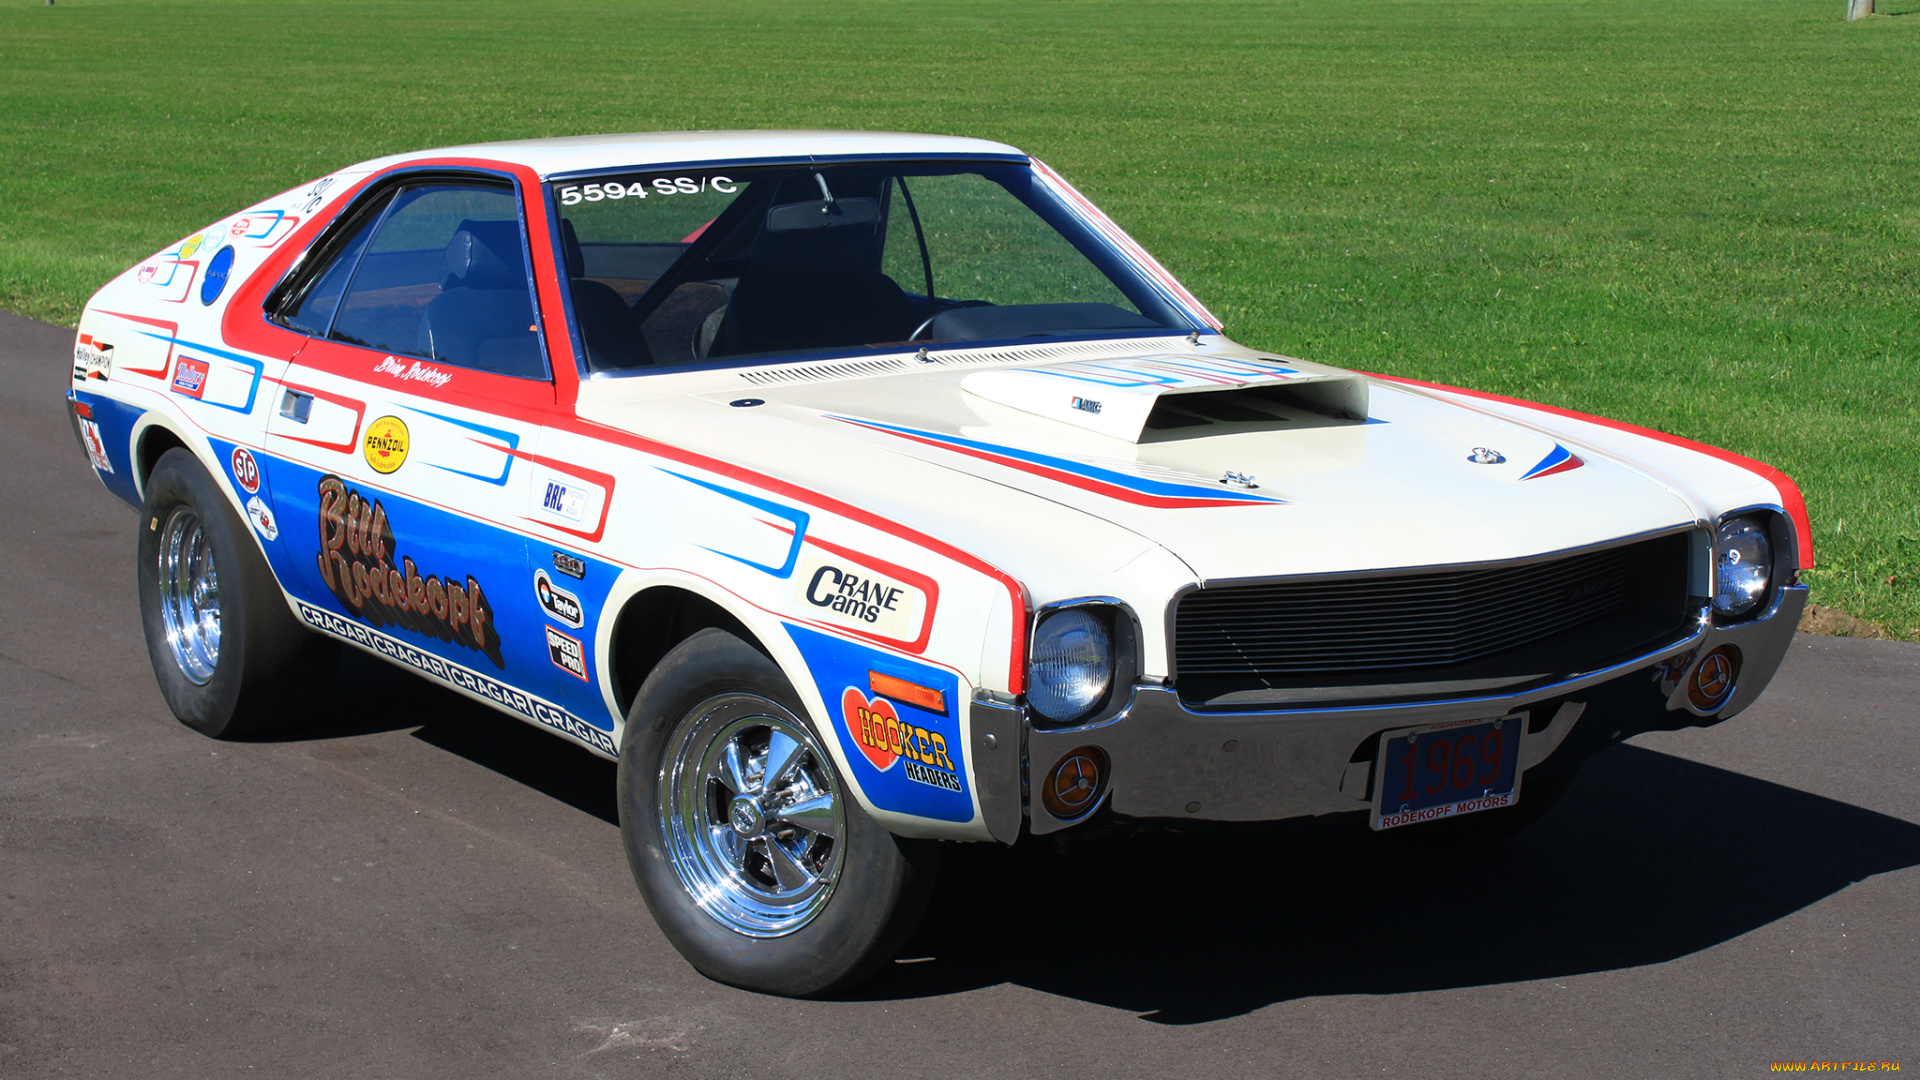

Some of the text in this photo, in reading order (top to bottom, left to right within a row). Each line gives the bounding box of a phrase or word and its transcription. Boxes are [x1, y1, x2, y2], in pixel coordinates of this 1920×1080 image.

[561, 176, 737, 206] 5594 SS/C
[90, 353, 111, 368] CHAMPION
[1081, 398, 1102, 415] AMC
[366, 436, 404, 452] PENNZOIL
[235, 451, 256, 484] STP
[543, 482, 567, 511] BRC
[318, 477, 387, 559] Bill
[806, 565, 904, 611] CRANE
[551, 592, 579, 617] Taylor
[548, 631, 579, 658] SPEED
[560, 651, 581, 673] PRO
[301, 605, 617, 755] CRAGAR CRAGAR CRAGAR CRAGAR
[857, 706, 956, 772] HOOKER
[904, 760, 963, 793] HEADERS
[1398, 729, 1504, 802] 1969
[1382, 795, 1509, 828] RODEKOPF MOTORS
